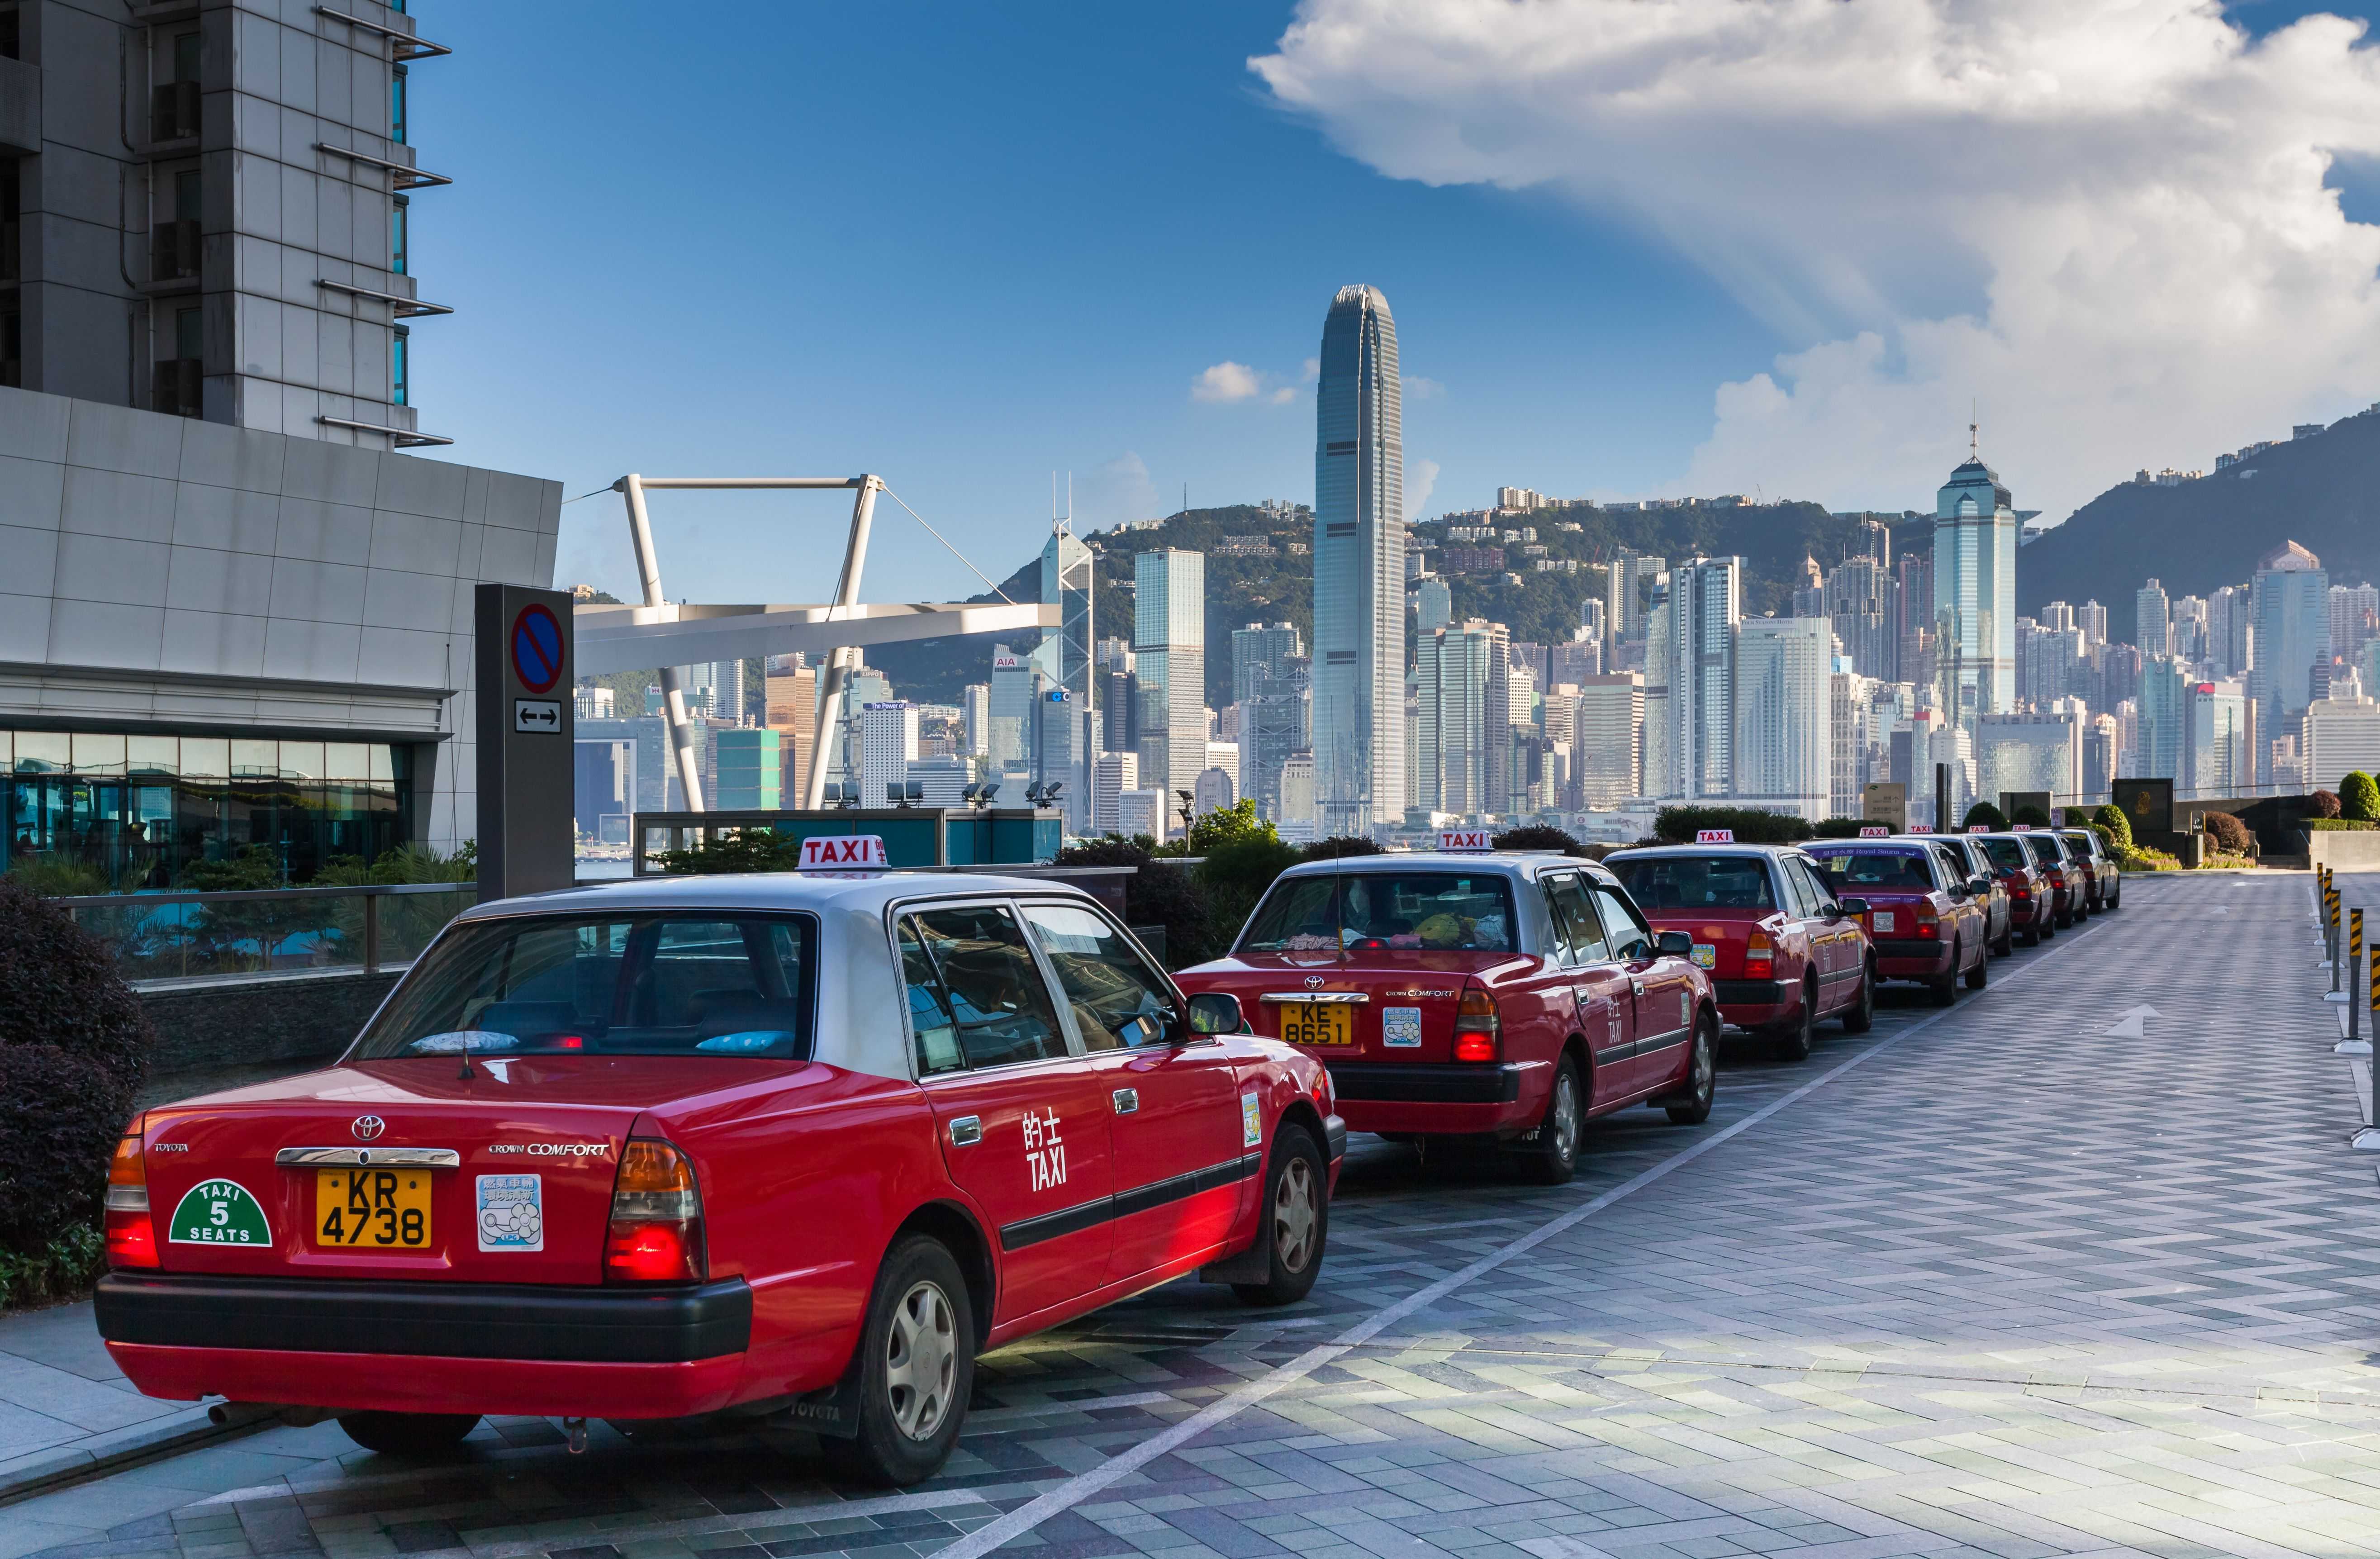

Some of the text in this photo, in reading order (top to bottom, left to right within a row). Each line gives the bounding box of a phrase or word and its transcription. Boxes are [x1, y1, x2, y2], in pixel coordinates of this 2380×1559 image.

[1443, 833, 1483, 847] TAXI
[1700, 832, 1729, 841] TAXI
[805, 840, 869, 863] TAXI
[875, 839, 886, 862] 的士
[1301, 1003, 1331, 1023] KE
[1286, 1023, 1342, 1043] 8651
[1608, 1020, 1621, 1043] TAXI
[1022, 1107, 1062, 1150] 的士
[154, 1144, 188, 1152] TOYOTA
[489, 1144, 609, 1156] CROWN COMFORT
[1026, 1145, 1066, 1192] TAXI
[199, 1184, 240, 1201] TAXI
[348, 1171, 398, 1208] KR
[210, 1201, 229, 1225] 5
[190, 1227, 250, 1241] SEATS
[323, 1207, 424, 1245] 4738
[790, 1404, 840, 1421] TOYOTA
